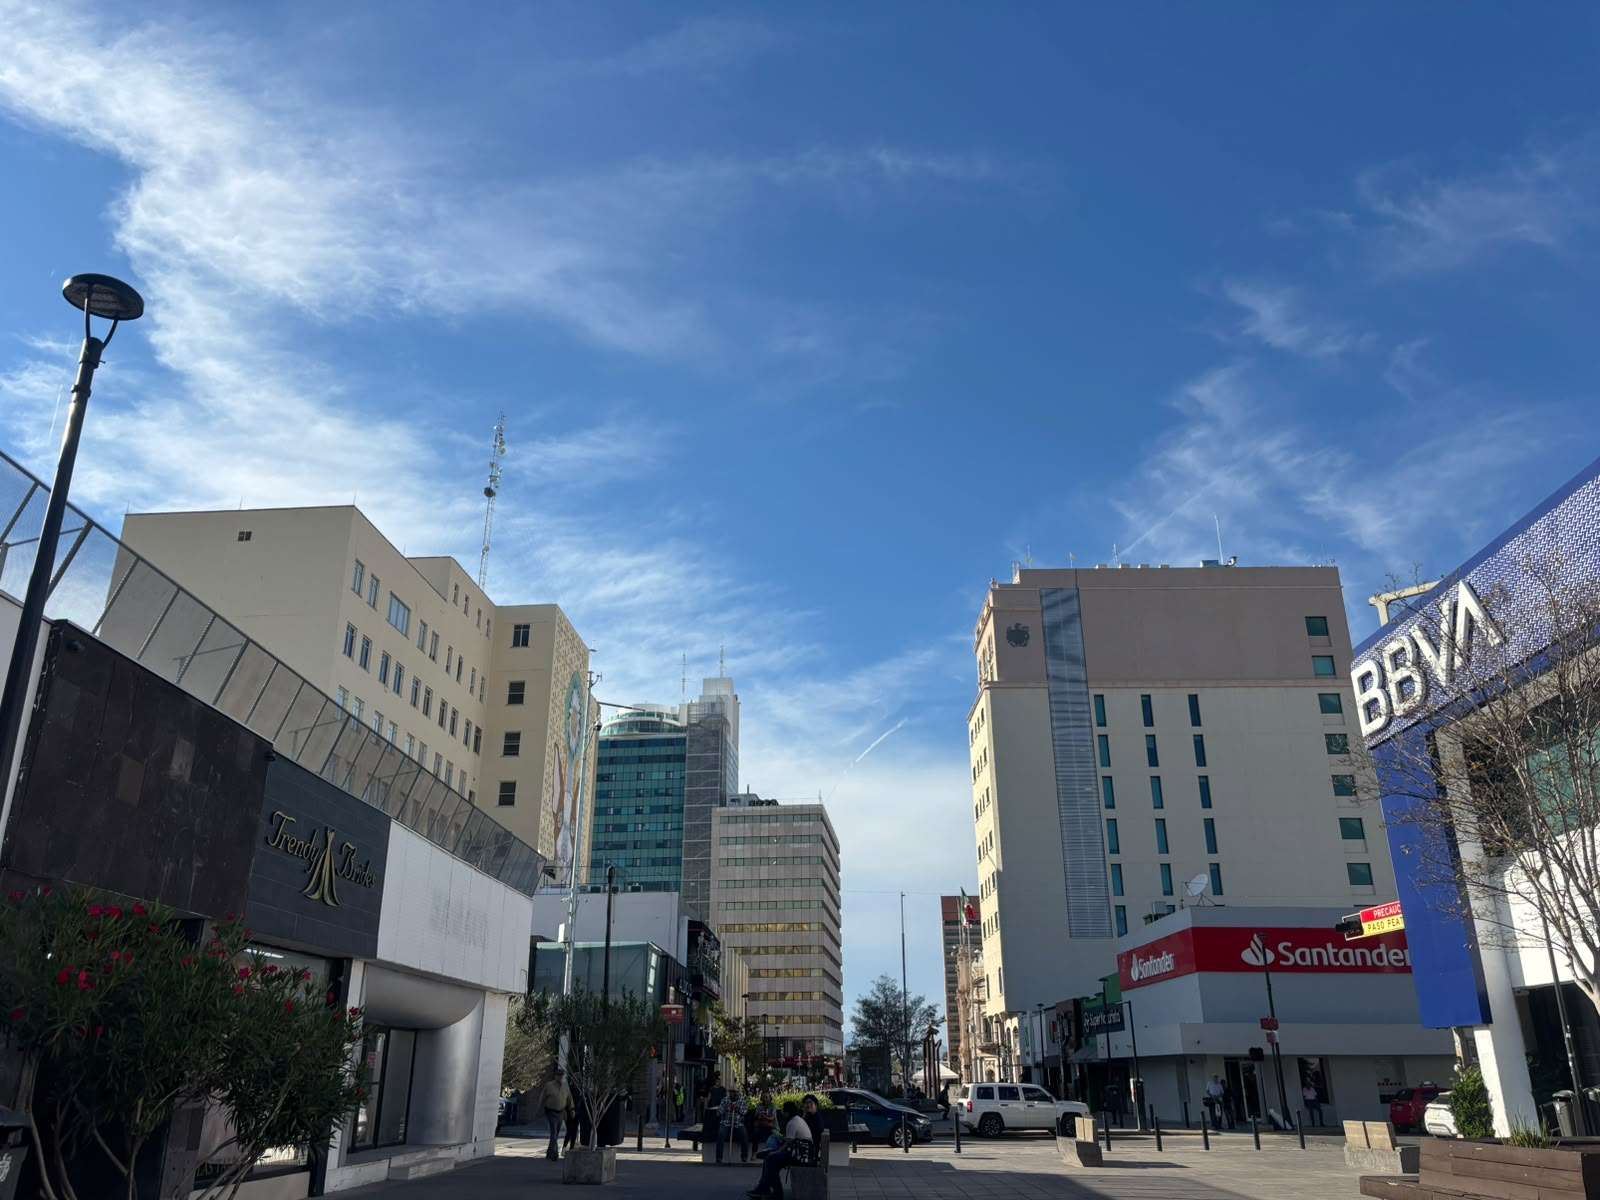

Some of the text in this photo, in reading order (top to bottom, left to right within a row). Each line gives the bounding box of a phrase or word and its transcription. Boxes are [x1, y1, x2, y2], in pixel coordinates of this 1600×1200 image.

[1351, 579, 1501, 738] BBVA
[266, 810, 320, 874] Trendy
[1367, 921, 1385, 932] PASO
[1138, 950, 1175, 980] Santander
